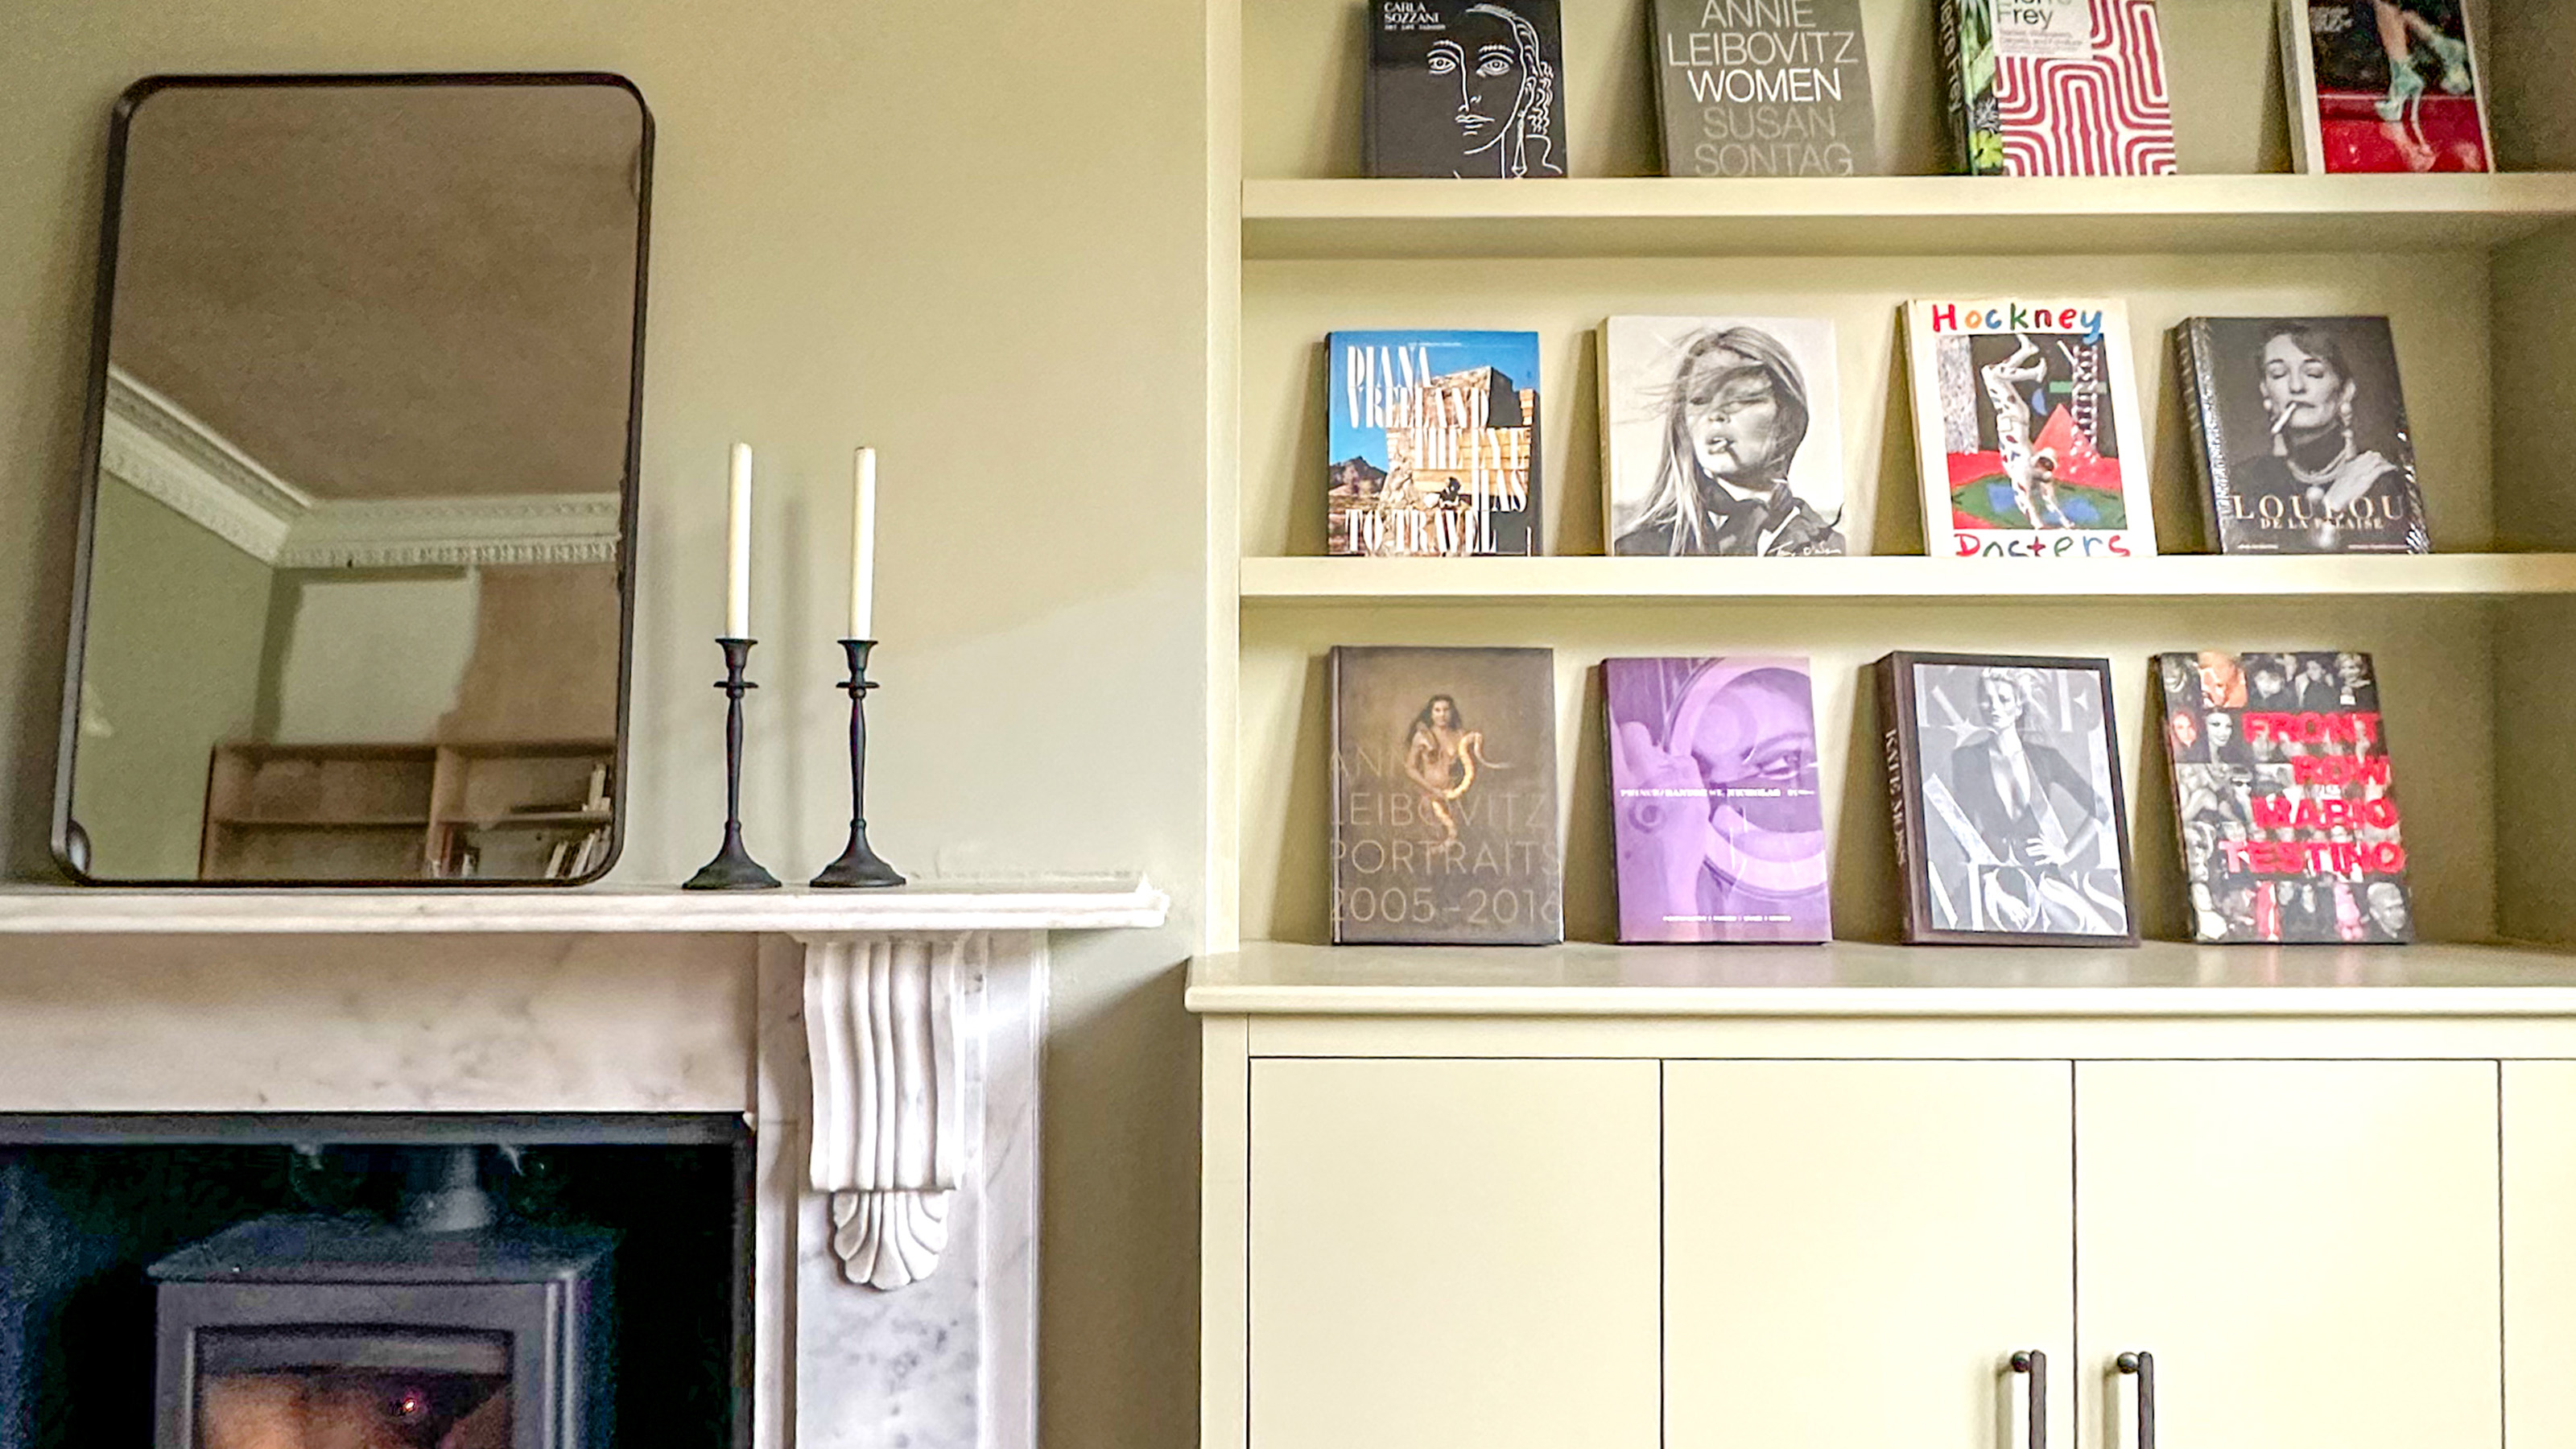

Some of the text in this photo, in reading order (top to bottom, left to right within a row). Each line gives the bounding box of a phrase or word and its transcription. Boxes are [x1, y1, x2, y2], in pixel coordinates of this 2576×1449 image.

[1384, 2, 1426, 12] CARLA
[1384, 12, 1439, 23] SOZZANI
[1701, 0, 1817, 28] ANNIE
[1997, 2, 2054, 30] Frey
[1667, 31, 1860, 66] LEIBOVITZ
[1687, 68, 1842, 102] WOMEN
[1703, 105, 1838, 139] SUSAN
[1695, 142, 1854, 176] SONTAG
[1933, 303, 2103, 344] Hockney
[1347, 346, 1432, 387] DIANA
[1347, 387, 1489, 428] VREELAND
[2228, 494, 2405, 520] LOULOU
[1345, 509, 1497, 555] TO TRAVEL
[2260, 518, 2283, 530] DE
[2288, 518, 2308, 530] LA
[2242, 712, 2381, 743] FRONT
[2291, 755, 2392, 786] ROW
[2252, 797, 2398, 829] MARIO
[1331, 838, 1559, 876] PORTRAITS
[2219, 841, 2407, 873] TESTINO
[1331, 887, 1560, 923] 2005-2016
